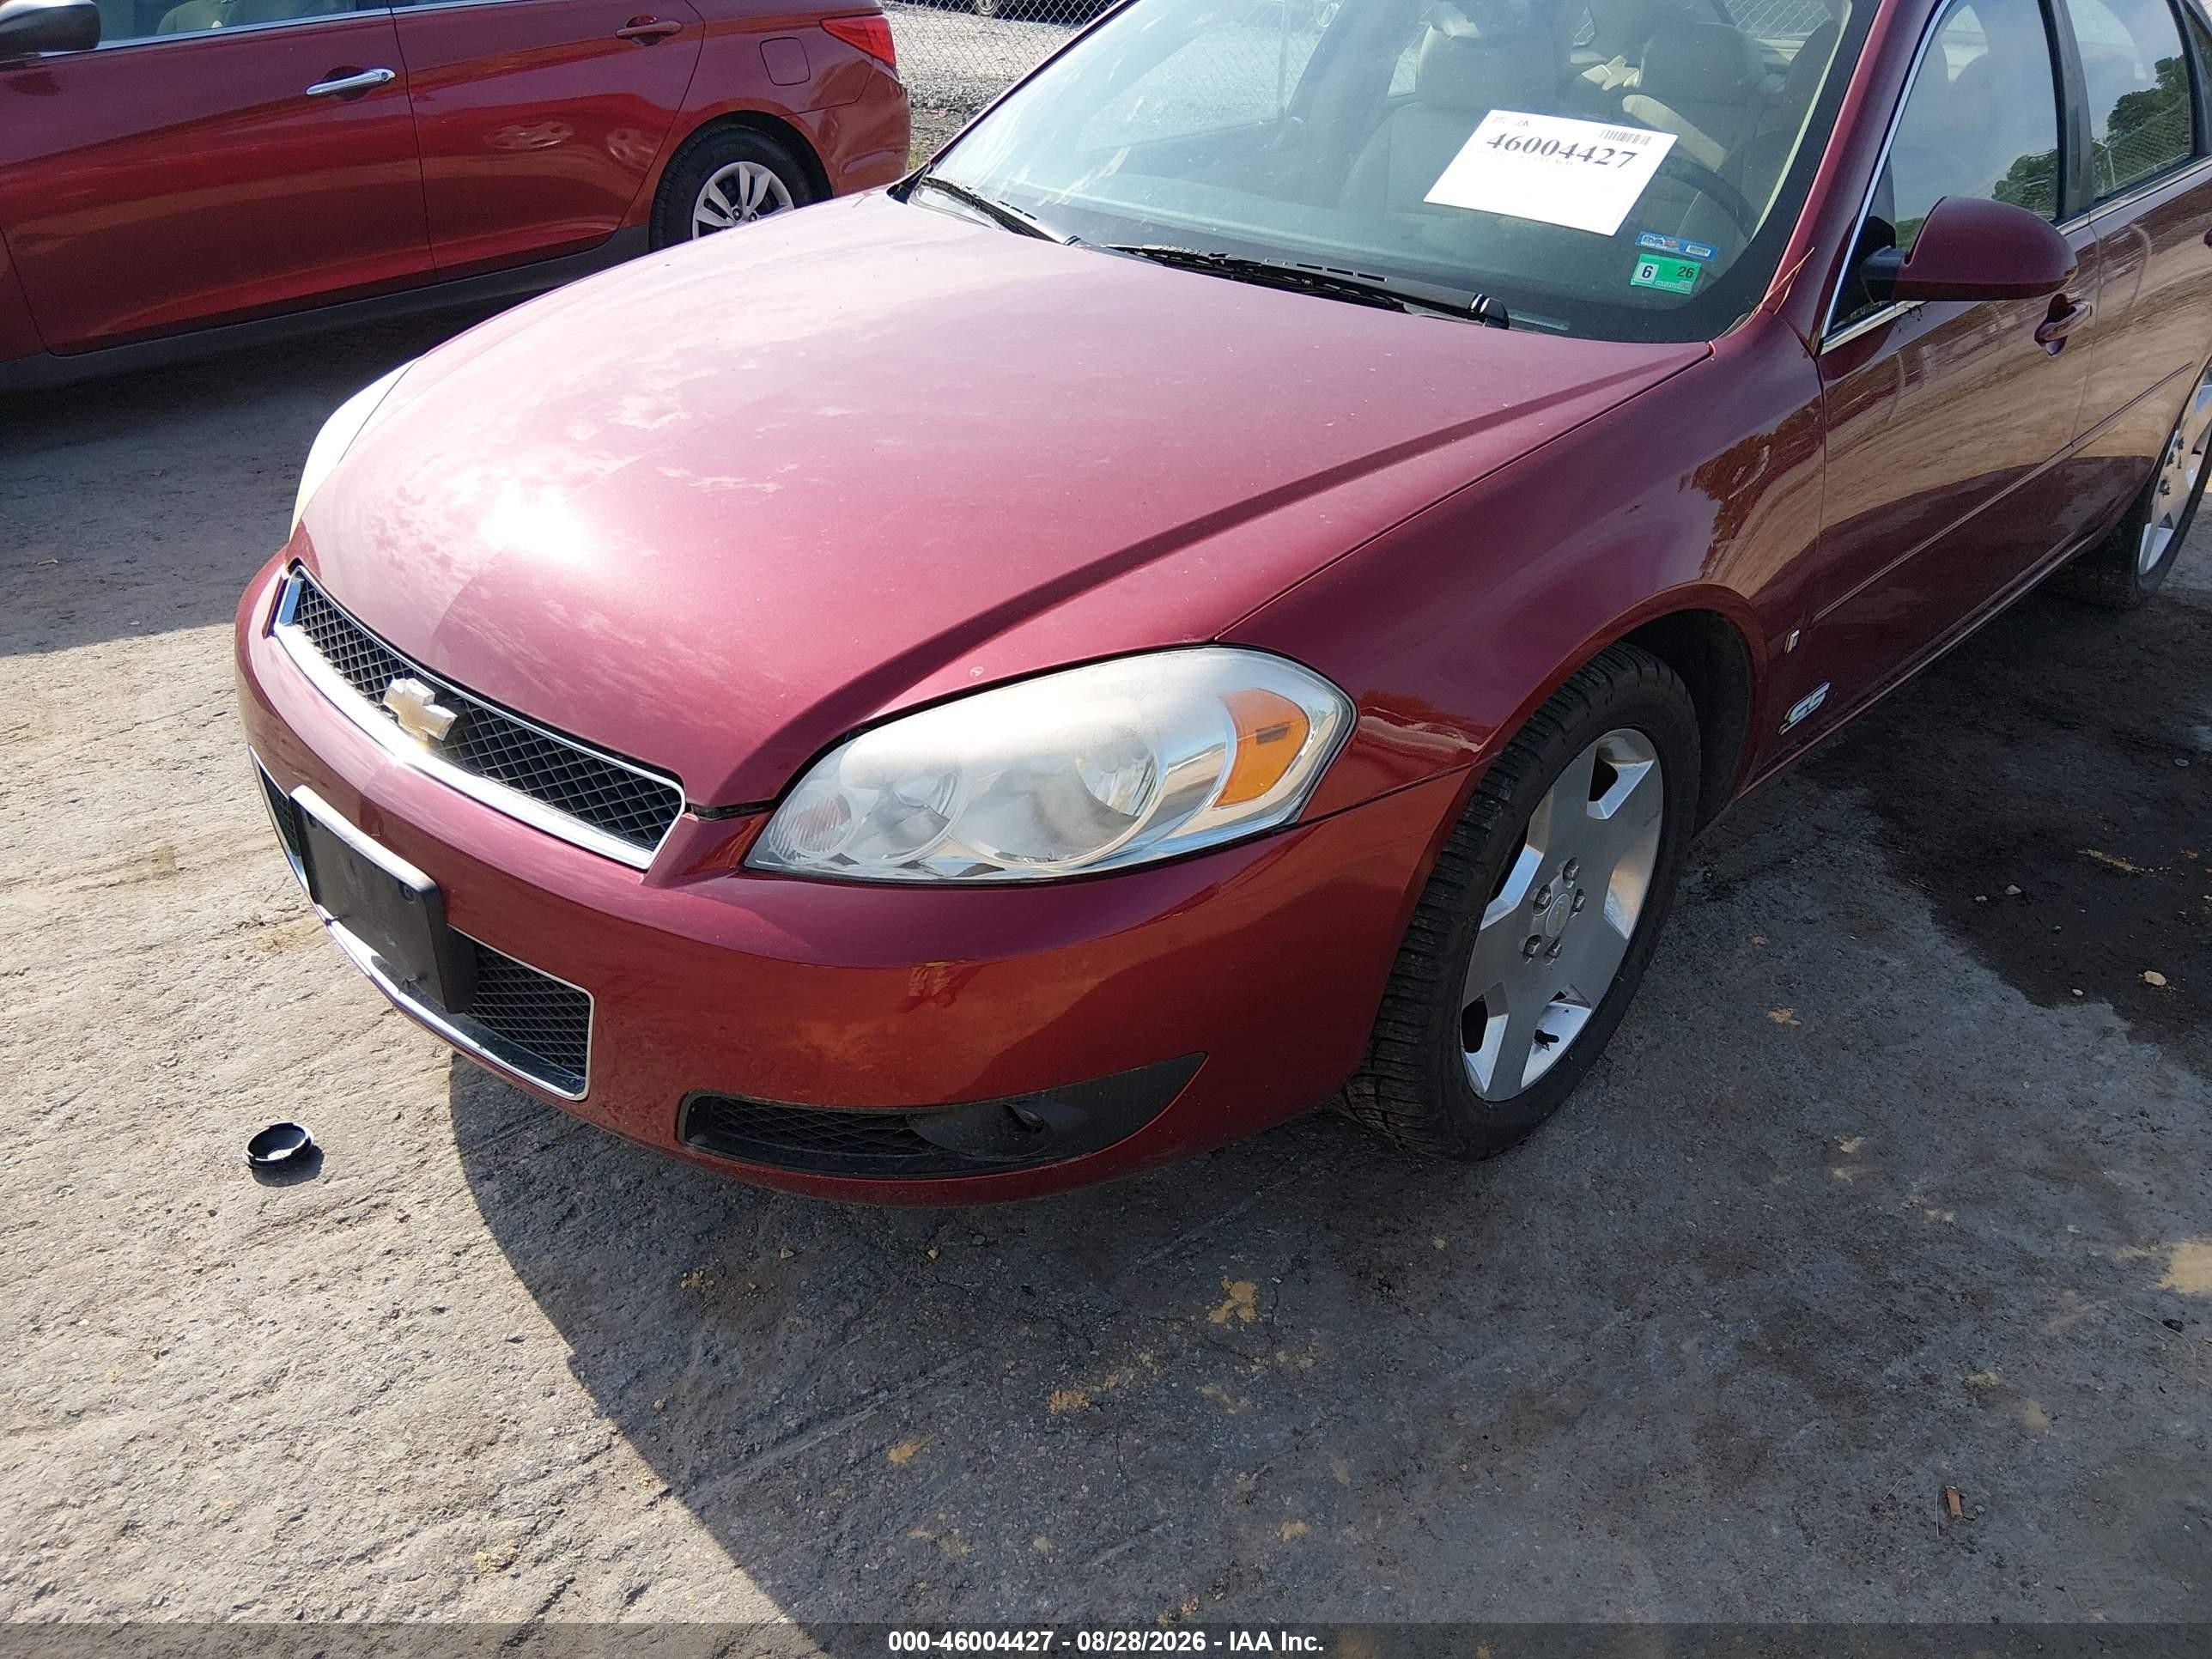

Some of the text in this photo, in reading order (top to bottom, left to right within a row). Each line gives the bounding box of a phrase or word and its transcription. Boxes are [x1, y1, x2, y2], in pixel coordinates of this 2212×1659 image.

[1486, 133, 1638, 168] 46004427
[1642, 265, 1694, 278] 6 26
[1779, 682, 1830, 736] SS
